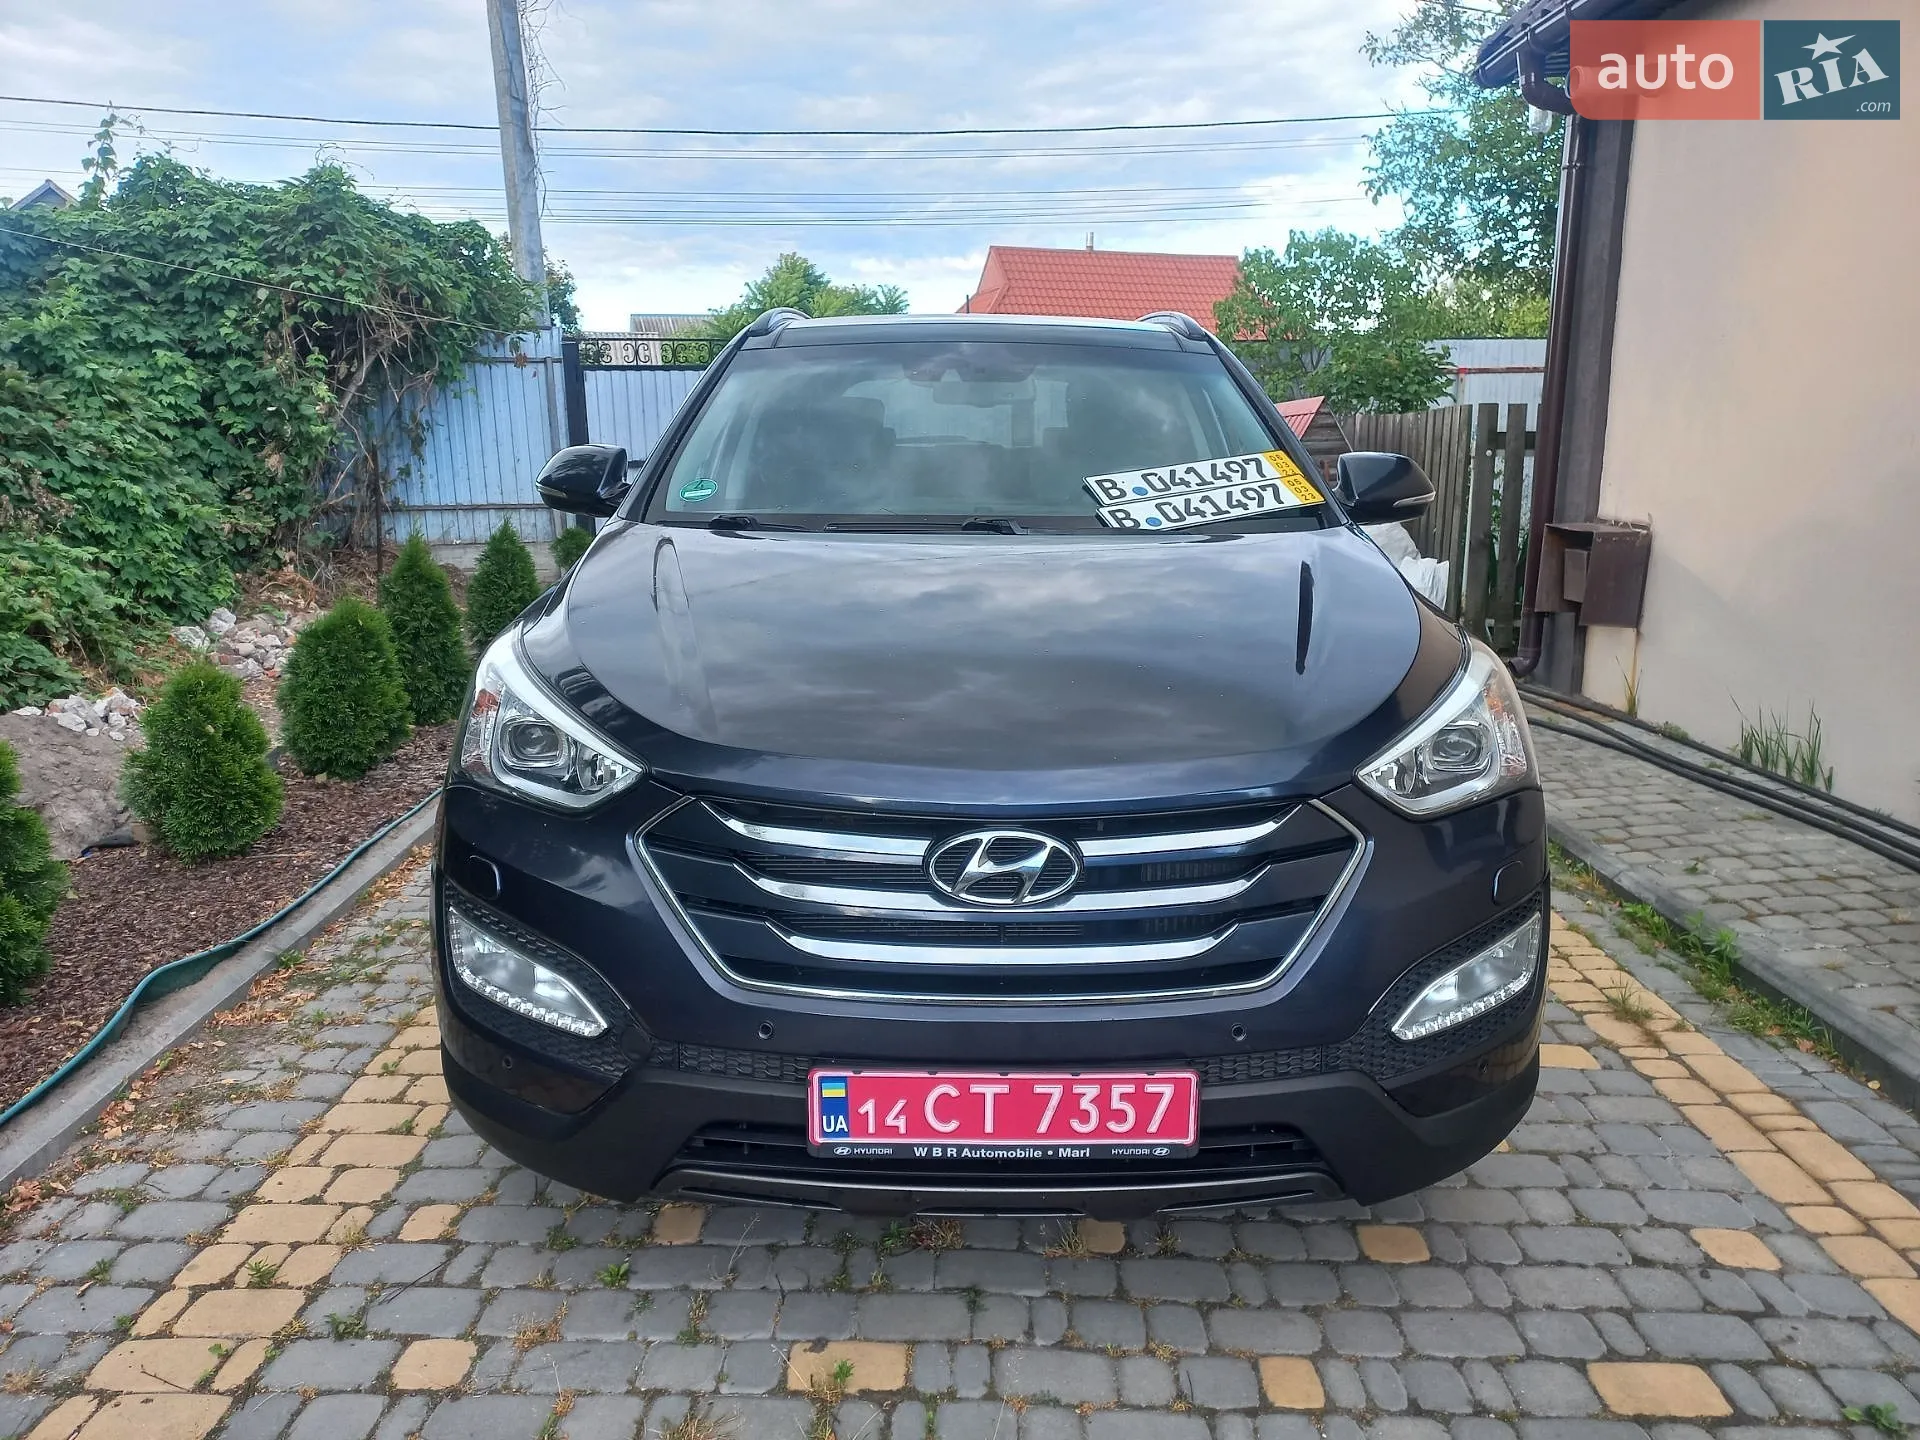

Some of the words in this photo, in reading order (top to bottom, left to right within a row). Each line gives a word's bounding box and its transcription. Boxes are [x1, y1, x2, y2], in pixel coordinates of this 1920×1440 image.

[1094, 478, 1127, 501] B
[1141, 457, 1267, 492] 041497
[1107, 508, 1141, 528] B
[1155, 483, 1284, 523] 041497
[822, 1115, 849, 1132] UA
[857, 1098, 908, 1134] 14
[924, 1083, 1010, 1134] CT
[1033, 1083, 1175, 1134] 7357
[853, 1147, 893, 1155] HYUNDAI
[961, 1147, 1043, 1158] Automobile
[1058, 1147, 1090, 1158] Marl
